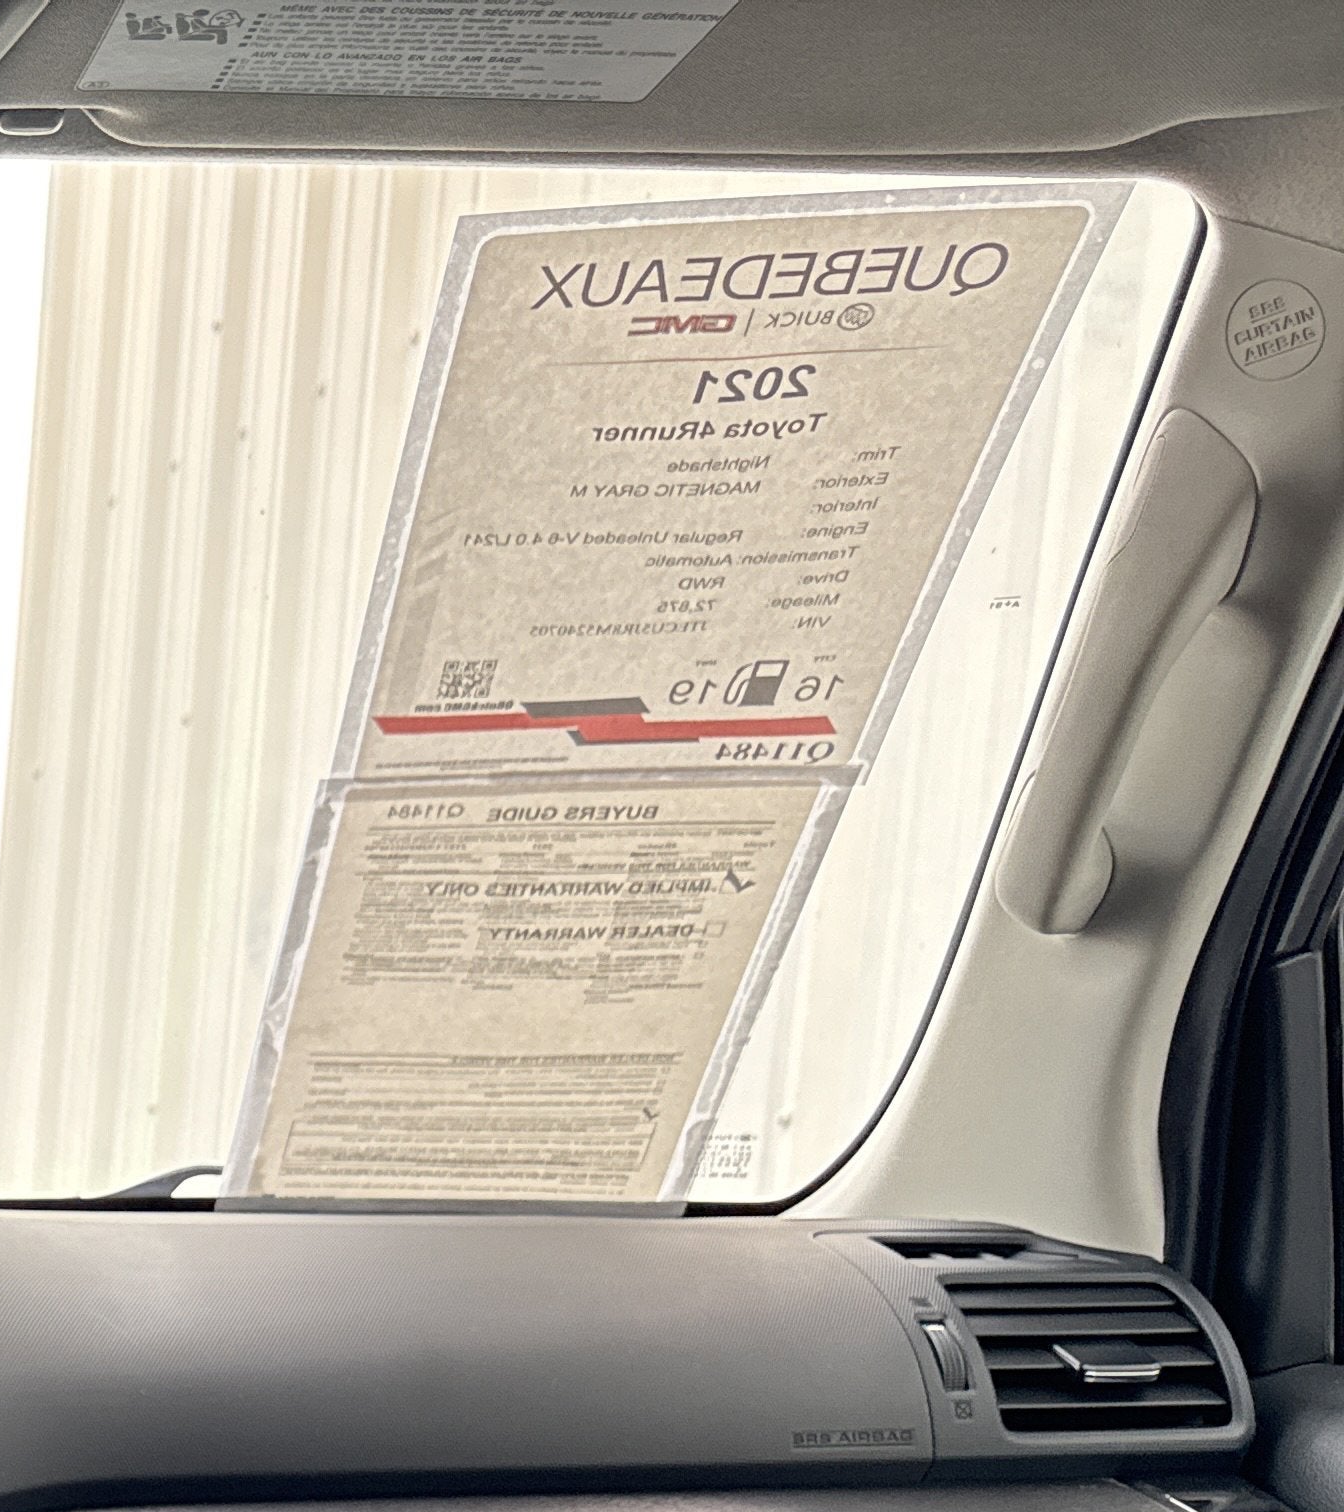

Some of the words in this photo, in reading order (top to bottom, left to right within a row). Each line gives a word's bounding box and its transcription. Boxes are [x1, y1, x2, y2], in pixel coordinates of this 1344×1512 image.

[321, 5, 355, 13] AVEC
[359, 6, 387, 14] DES
[391, 7, 454, 15] COUSSINS
[459, 8, 478, 16] DE
[481, 8, 545, 18] SÉCURITÉ
[547, 10, 569, 18] DE
[570, 10, 639, 19] NOUVELLE
[283, 52, 310, 60] CON
[336, 53, 403, 62] AVANZADO
[487, 56, 523, 64] BAGS
[1233, 306, 1316, 346] CURTAIN
[1244, 326, 1317, 362] AIRBAG
[838, 1429, 914, 1444] AIRBAG
